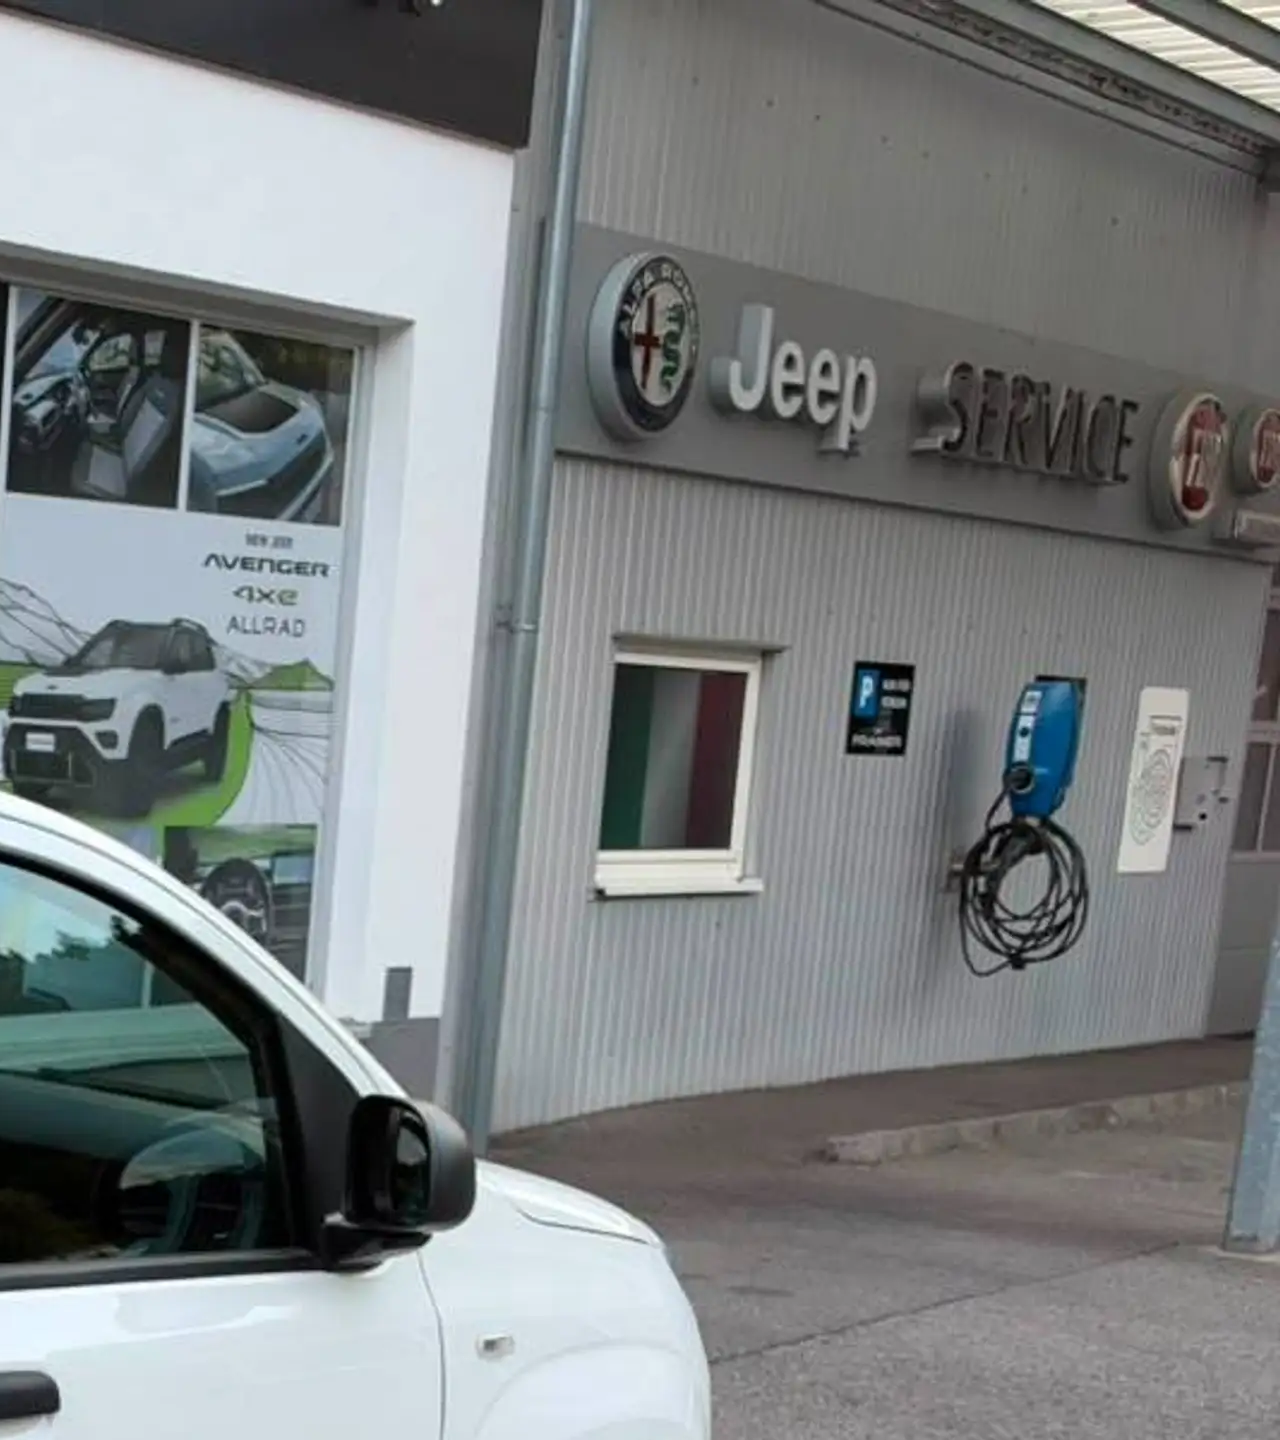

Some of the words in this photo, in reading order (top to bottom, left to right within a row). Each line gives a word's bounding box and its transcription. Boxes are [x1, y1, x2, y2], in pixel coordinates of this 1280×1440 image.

[724, 304, 878, 451] Jeep
[939, 361, 1140, 485] SERVICE
[203, 553, 330, 578] AVENGER
[226, 615, 306, 638] ALLRAD
